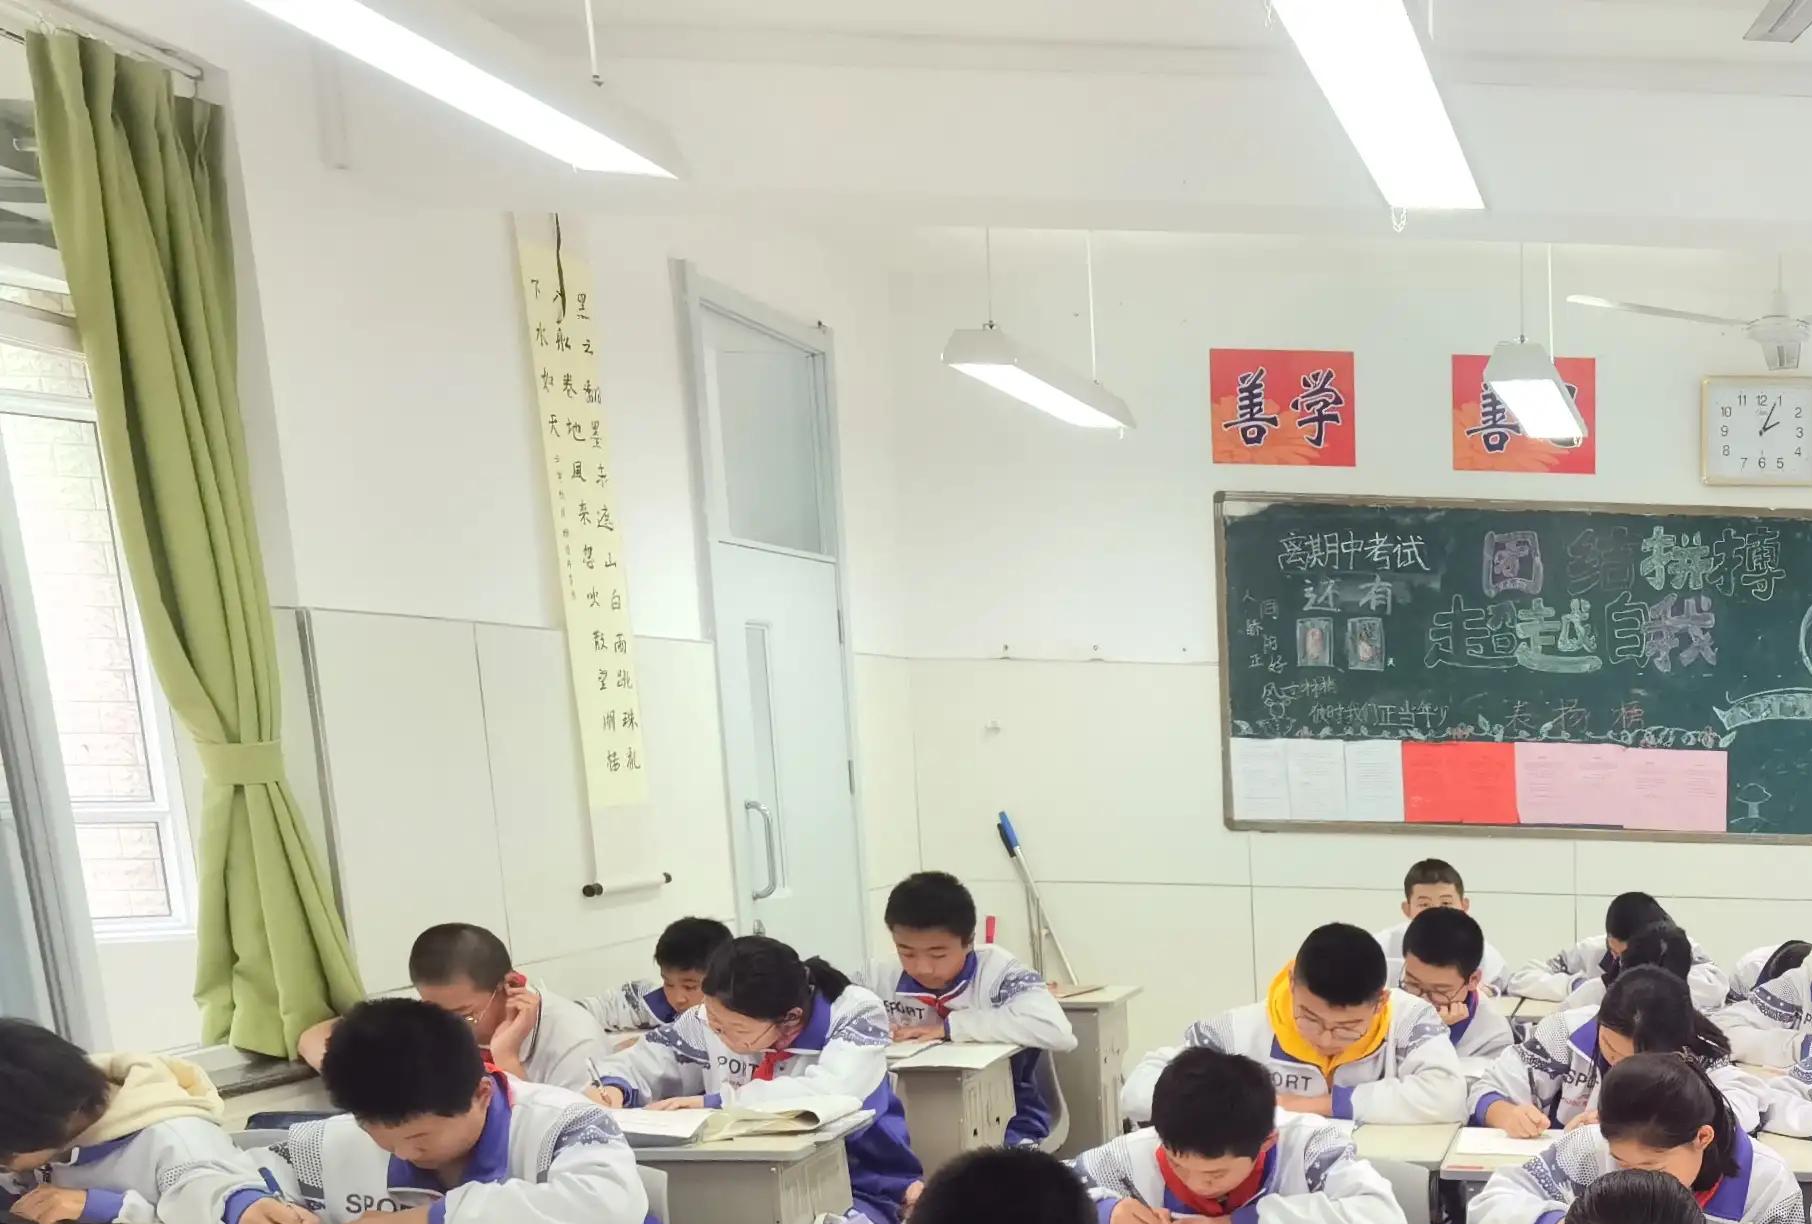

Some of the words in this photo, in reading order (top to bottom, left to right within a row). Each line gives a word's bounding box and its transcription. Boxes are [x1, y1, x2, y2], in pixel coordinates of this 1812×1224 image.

[1737, 394, 1747, 406] 11
[1756, 394, 1768, 407] 12
[1223, 367, 1345, 449] 善学
[1721, 406, 1732, 418] 10
[1794, 406, 1802, 418] 2
[1720, 424, 1729, 437] 9
[1796, 426, 1804, 438] 3
[1722, 444, 1730, 456] 8
[1794, 446, 1802, 456] 4
[1740, 457, 1748, 469] 7
[1758, 457, 1766, 469] 6
[1776, 457, 1784, 469] 5
[1277, 530, 1431, 571] 离期中考试
[1303, 574, 1392, 615] 还有
[1424, 592, 1719, 673] 超越自我
